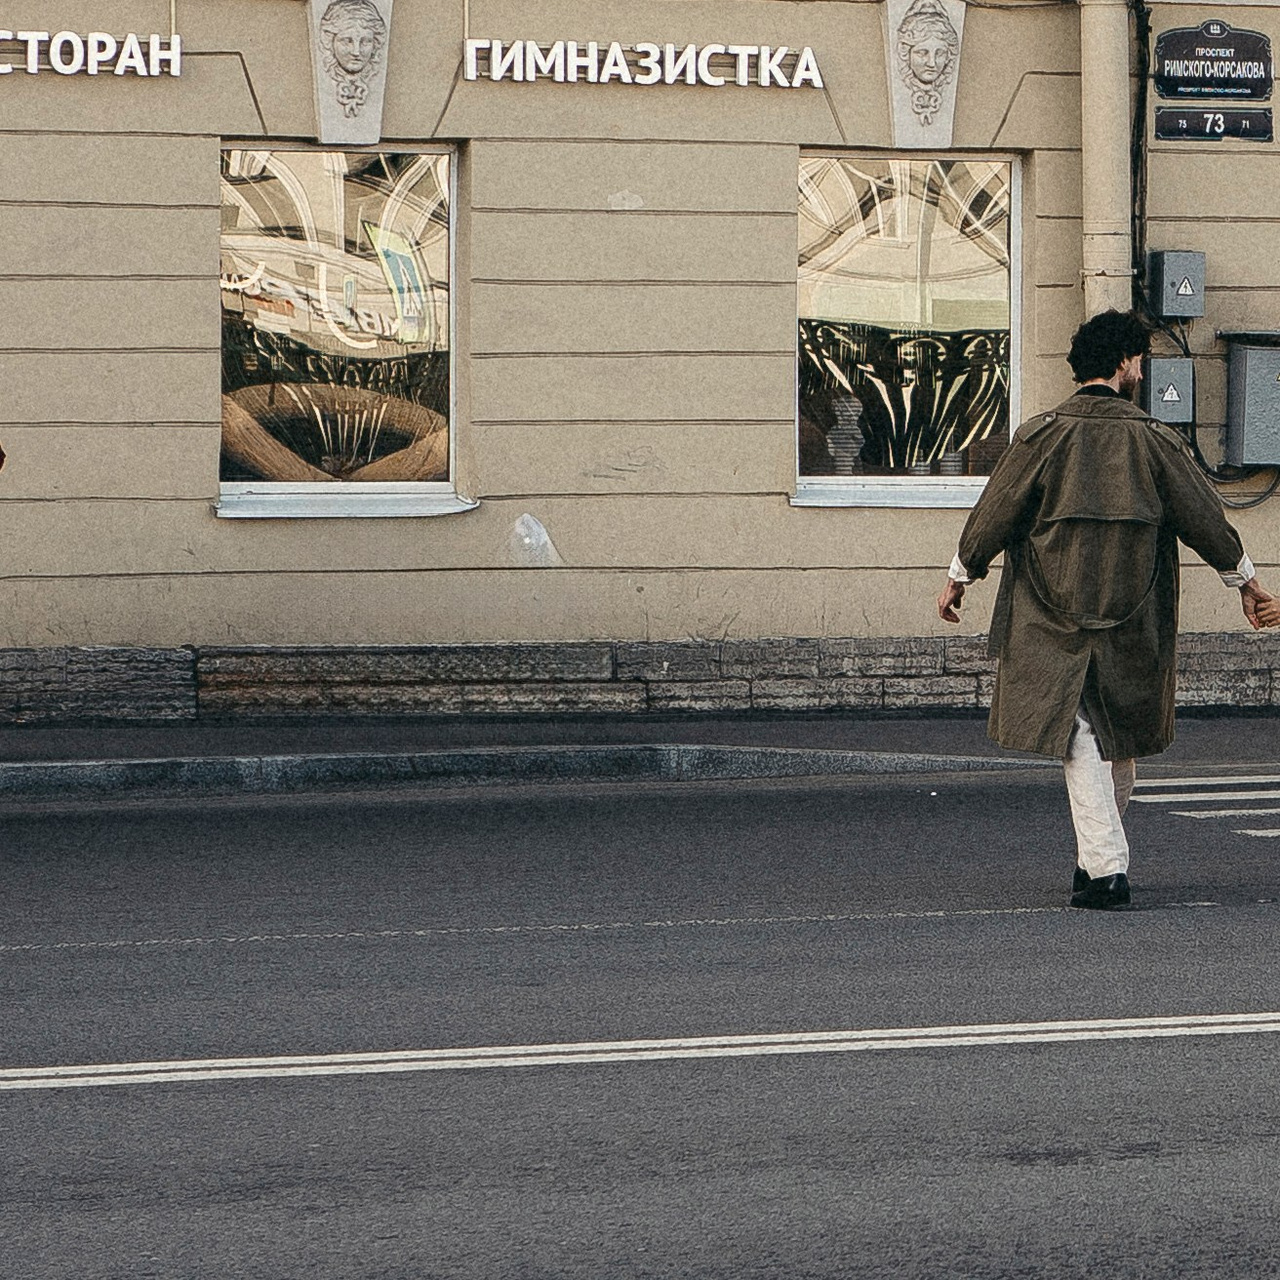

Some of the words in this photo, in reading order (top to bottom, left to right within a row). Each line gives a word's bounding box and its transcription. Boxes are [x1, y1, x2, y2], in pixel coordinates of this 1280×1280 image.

[1195, 47, 1235, 58] ПРОСПЕКТ
[464, 38, 824, 88] ГИМНАЗИСТКА
[1164, 59, 1266, 79] РИМСКОГО-КОРСАКОВА
[1178, 119, 1188, 129] 75
[1203, 113, 1226, 134] 73
